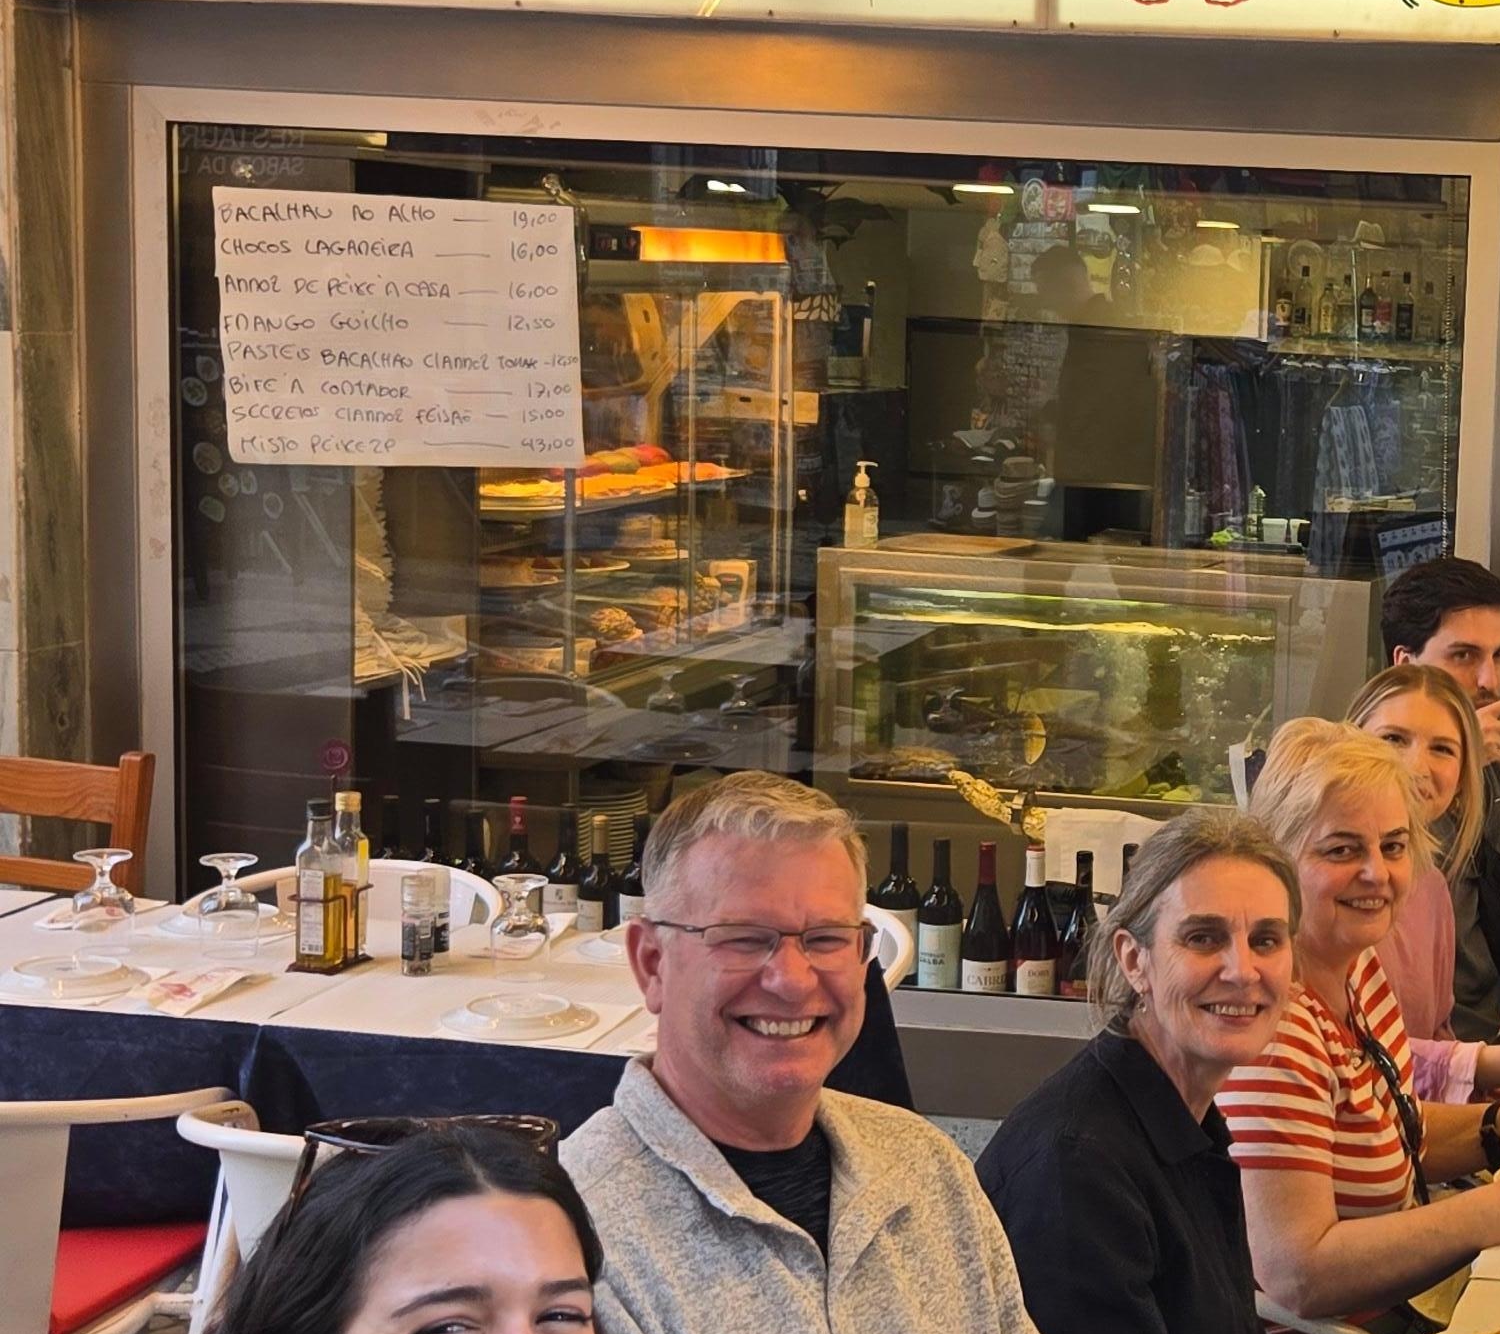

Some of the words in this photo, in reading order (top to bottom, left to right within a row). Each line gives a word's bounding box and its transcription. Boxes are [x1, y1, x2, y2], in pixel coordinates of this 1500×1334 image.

[218, 202, 333, 223] BACALHAU
[388, 203, 436, 223] ALHO
[512, 210, 558, 229] 19,00
[220, 237, 292, 256] CHOCOS
[510, 240, 558, 261] 16,00
[404, 281, 451, 299] CASA
[508, 281, 559, 300] 16,00
[507, 315, 556, 332] 12,50
[527, 381, 572, 398] 17,00
